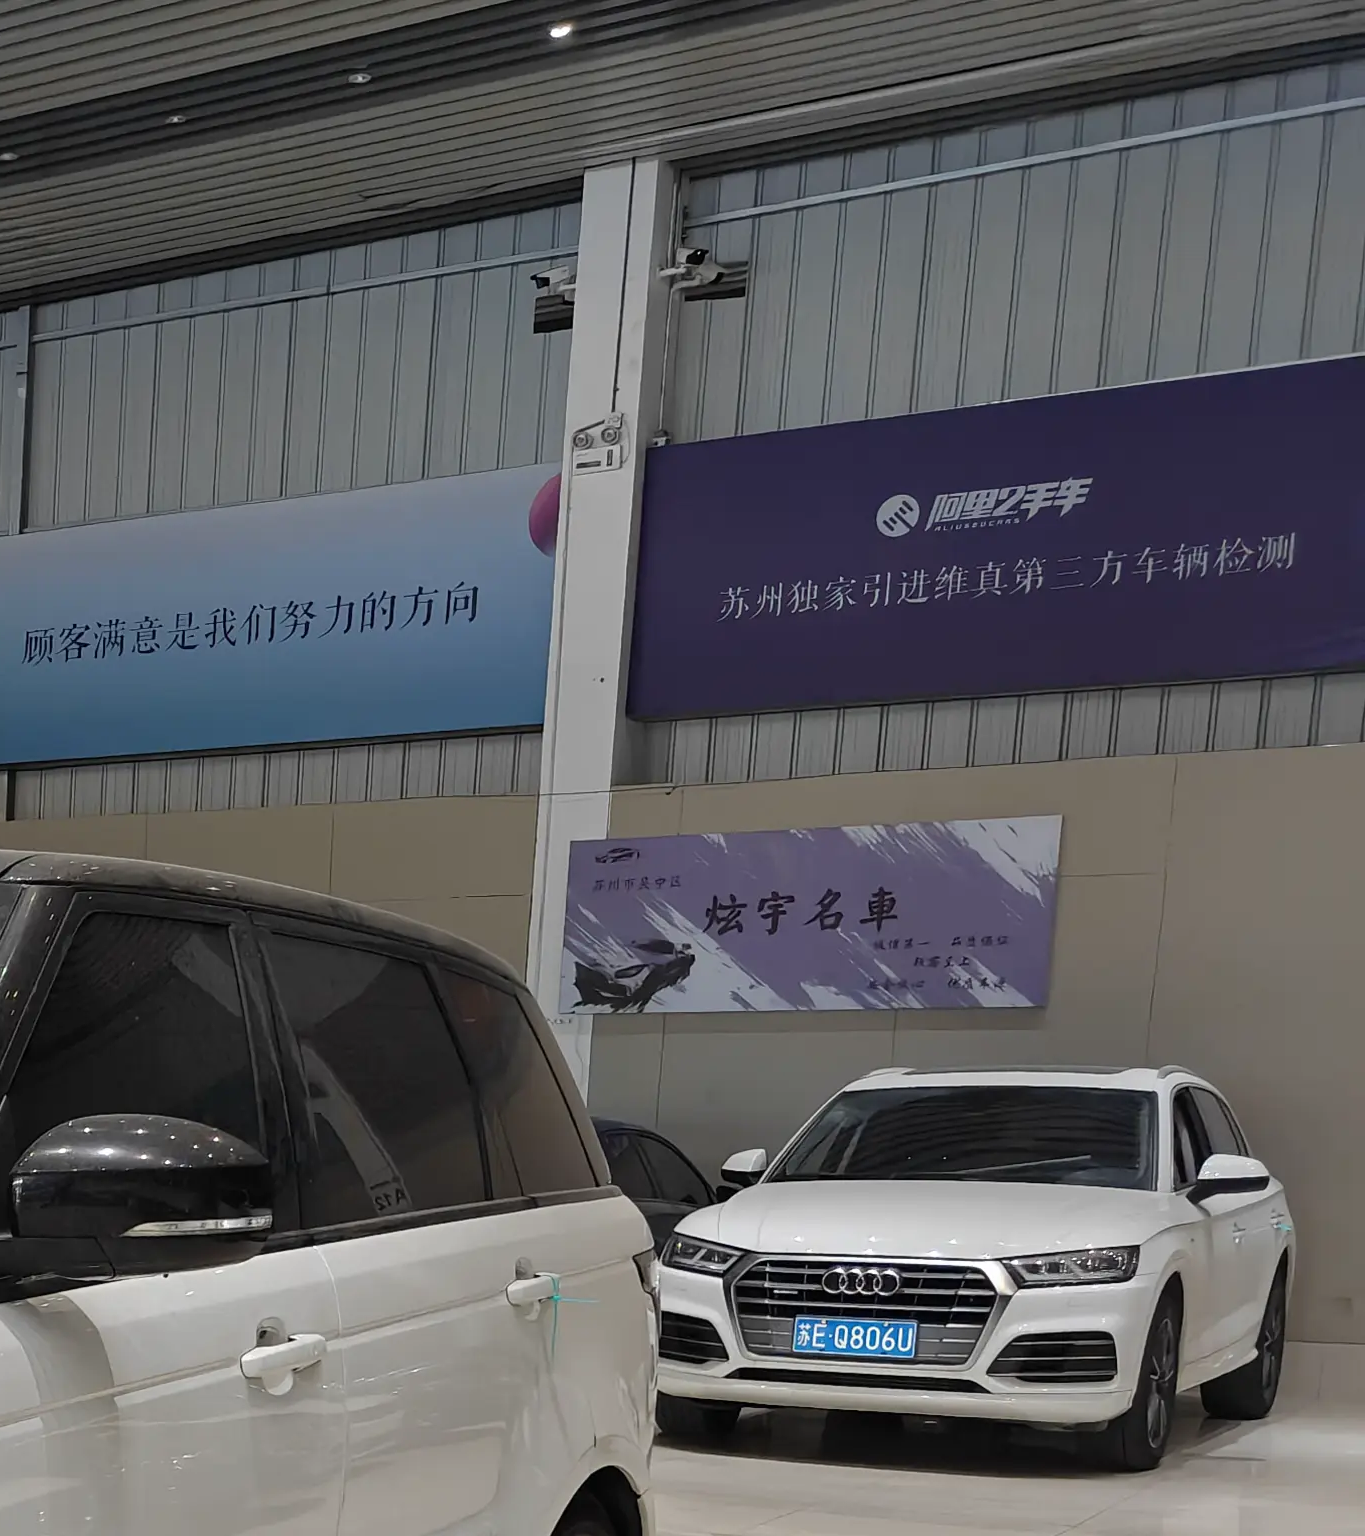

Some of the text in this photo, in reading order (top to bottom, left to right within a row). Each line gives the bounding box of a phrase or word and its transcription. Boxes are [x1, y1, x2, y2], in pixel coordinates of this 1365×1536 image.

[925, 477, 1093, 531] 阿里2手车
[716, 532, 1296, 622] 苏州独家引进维真第三方车辆检测
[21, 581, 479, 665] 顾客满意是我们努力的方向
[702, 886, 898, 936] 炫宇名車
